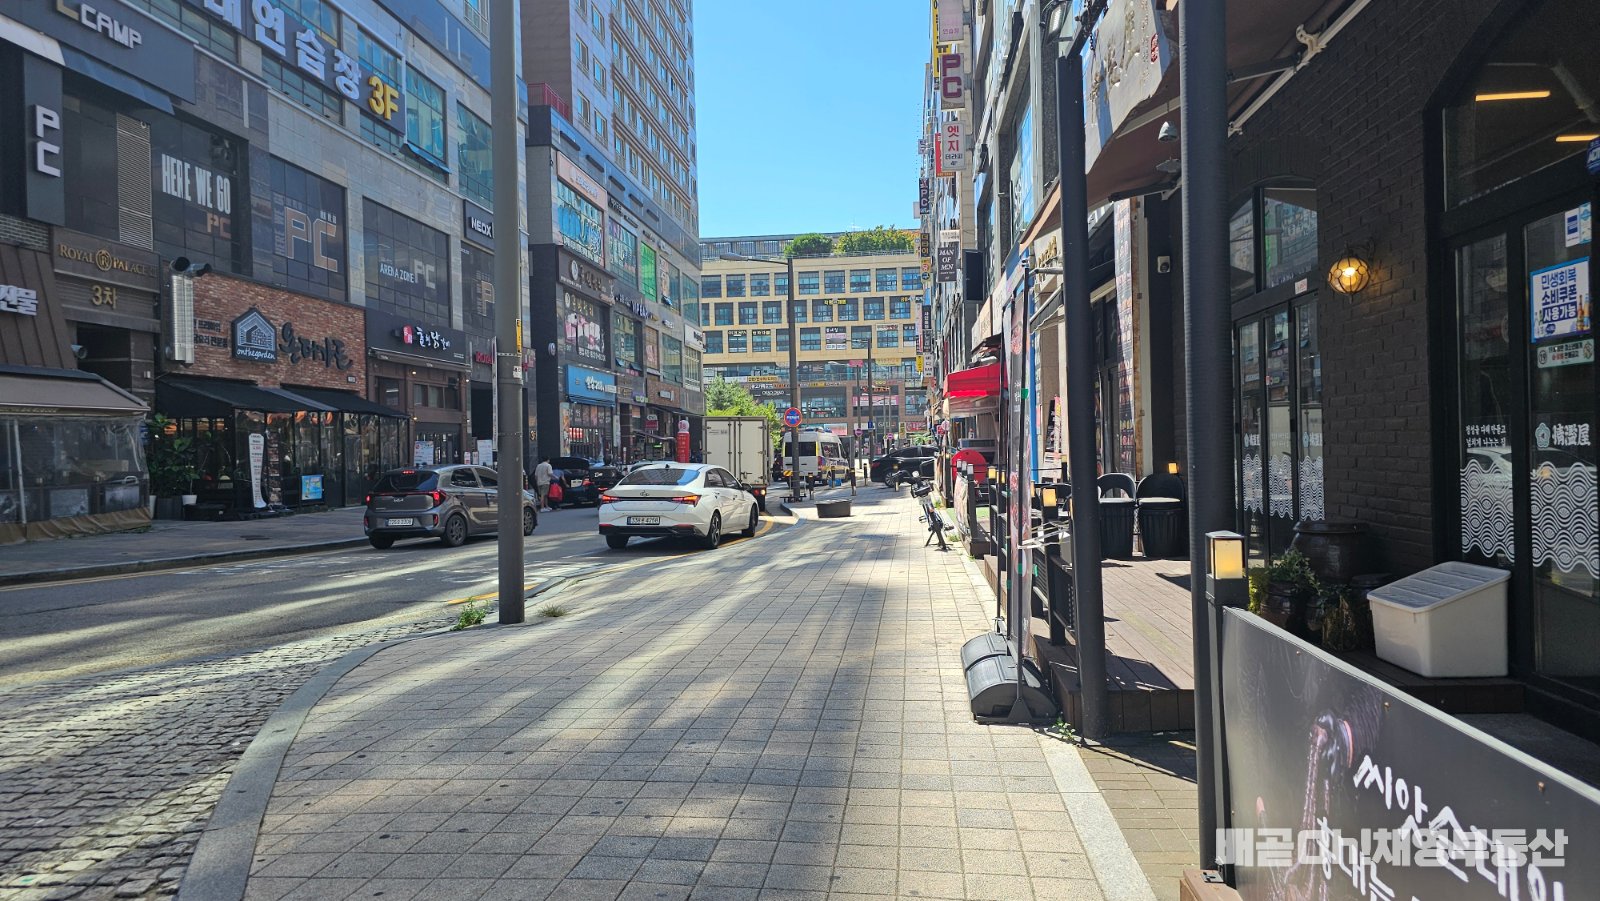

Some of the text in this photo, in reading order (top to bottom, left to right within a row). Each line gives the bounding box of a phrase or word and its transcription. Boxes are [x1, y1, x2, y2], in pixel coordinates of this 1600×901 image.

[80, 4, 142, 48] CAMP
[942, 54, 962, 98] PC
[35, 104, 61, 177] PC
[161, 153, 231, 214] HERE WE GO
[284, 206, 338, 272] PC
[60, 244, 95, 264] ROYAL
[113, 256, 145, 274] PALACE
[414, 259, 436, 289] PC
[1541, 267, 1577, 290] 민생회복
[92, 284, 117, 309] 3차
[1541, 284, 1577, 306] 소비쿠폰
[1543, 303, 1577, 322] 사용가능
